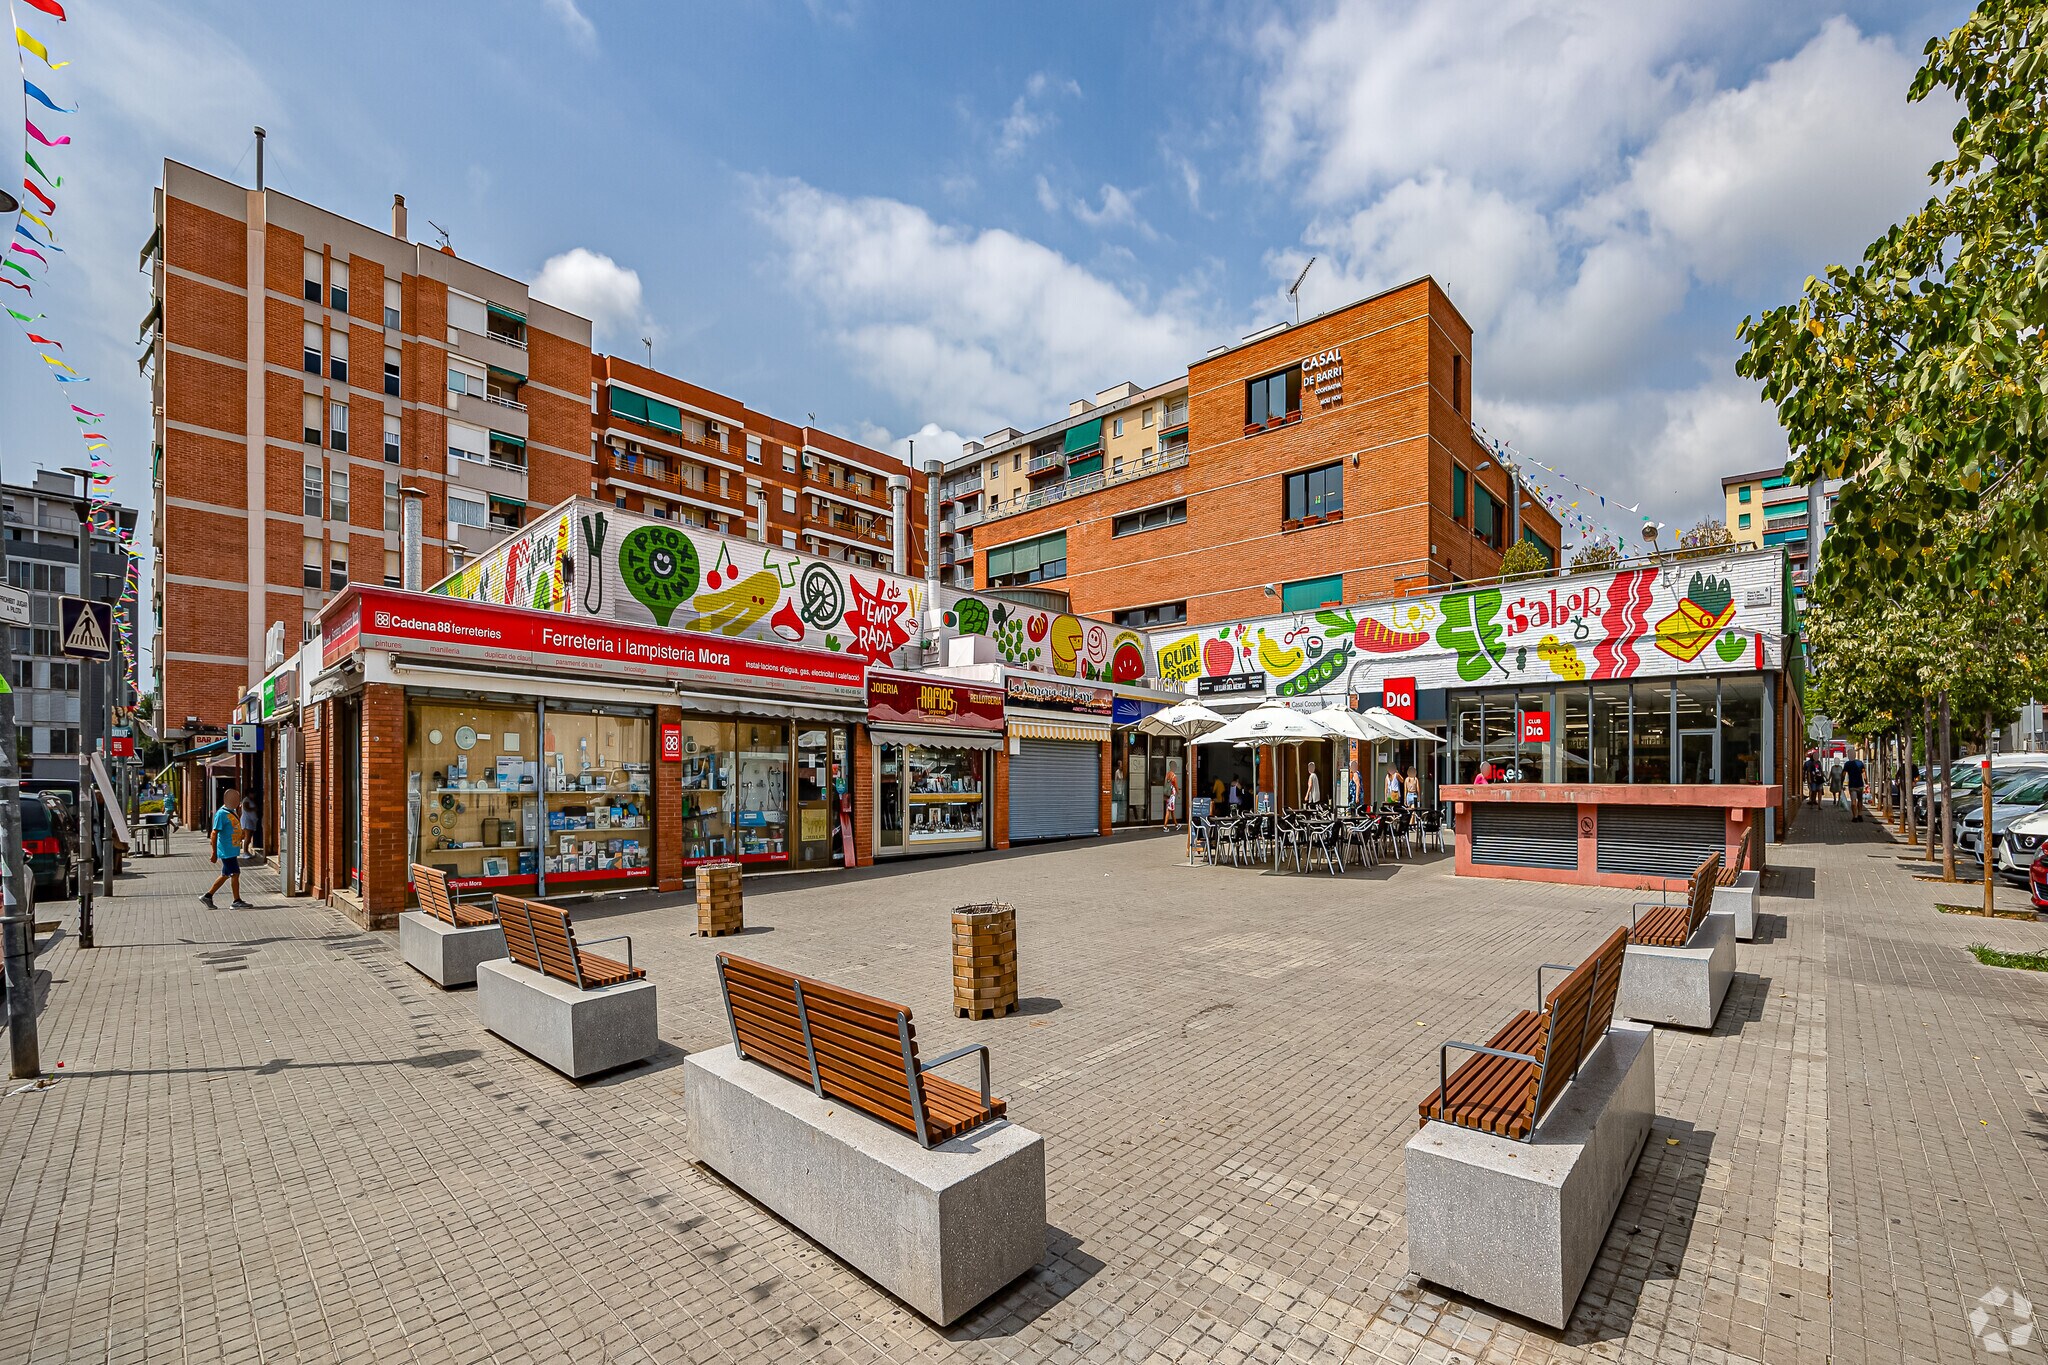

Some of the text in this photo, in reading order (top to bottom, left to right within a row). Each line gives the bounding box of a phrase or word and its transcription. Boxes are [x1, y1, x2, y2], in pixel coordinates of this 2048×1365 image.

[1302, 348, 1342, 371] CASAL
[1304, 366, 1342, 386] DE BARRI
[628, 528, 695, 601] PROXIMITAT
[887, 580, 902, 600] de
[858, 592, 899, 629] TEMPO
[452, 623, 502, 639] ferreteries
[859, 624, 894, 652] RADA
[375, 640, 402, 649] pintures
[485, 651, 507, 660] duplicat
[542, 628, 730, 666] Ferreteria i lampisteria Mora
[871, 682, 898, 695] JOIERIA
[921, 686, 954, 711] RAMOS
[1009, 679, 1020, 693] La
[1060, 685, 1071, 698] del
